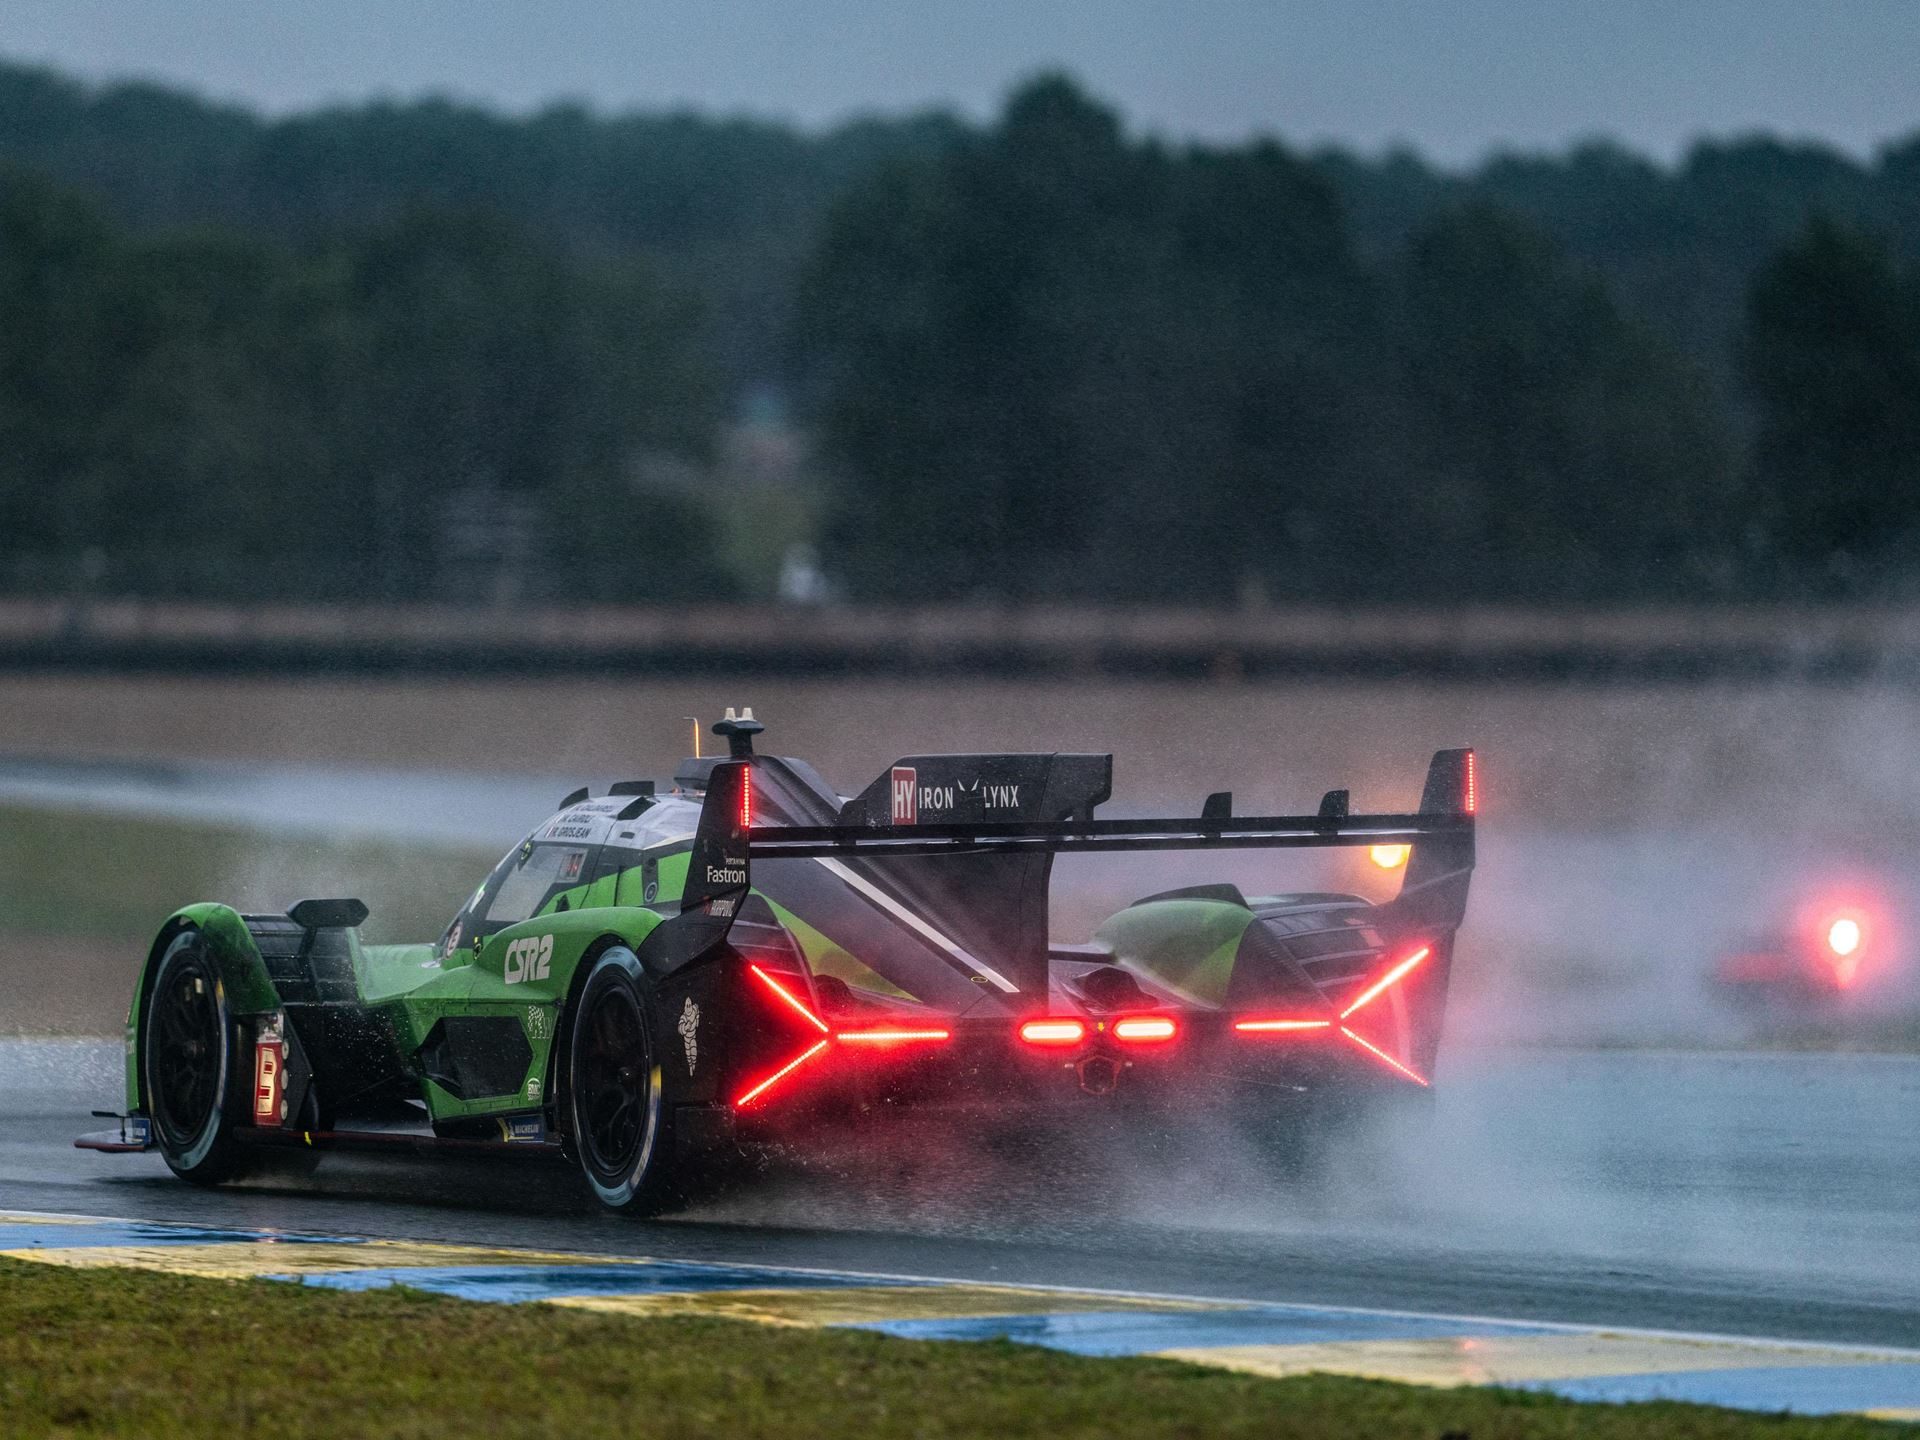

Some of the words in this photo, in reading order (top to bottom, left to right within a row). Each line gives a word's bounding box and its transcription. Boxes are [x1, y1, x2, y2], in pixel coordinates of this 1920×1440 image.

[894, 780, 915, 819] HY
[919, 787, 954, 809] IRON
[983, 785, 1019, 808] LYNX
[557, 826, 592, 839] GROSJEAN
[706, 865, 746, 884] Fastron
[504, 934, 554, 985] CSR2
[514, 1123, 541, 1134] MICHELIN
